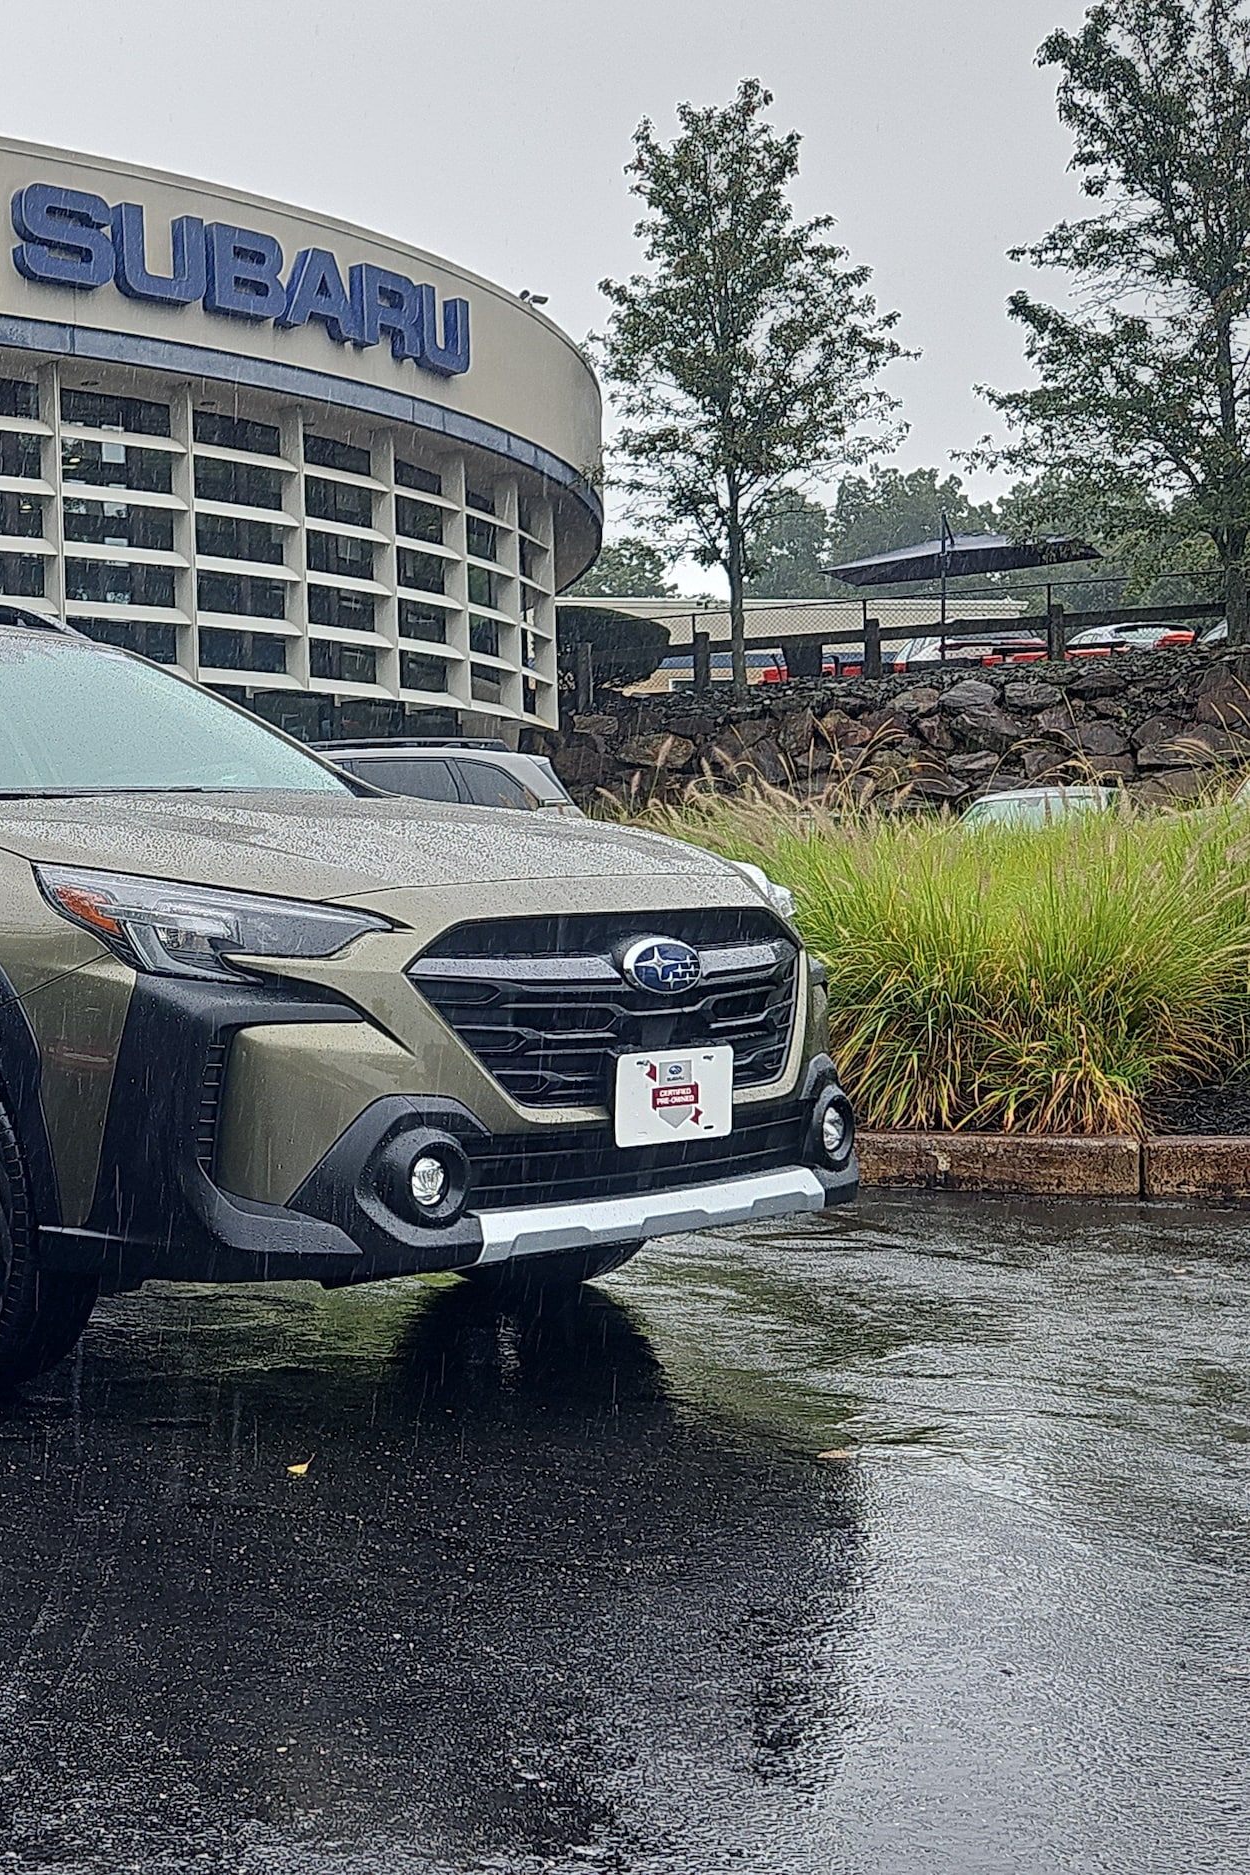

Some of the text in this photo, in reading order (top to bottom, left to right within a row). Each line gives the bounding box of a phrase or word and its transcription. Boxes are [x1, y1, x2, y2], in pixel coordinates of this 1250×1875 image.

[11, 182, 470, 377] SUBARU
[659, 1087, 692, 1097] CERTIFIED
[656, 1094, 695, 1106] PRE-OWNED
